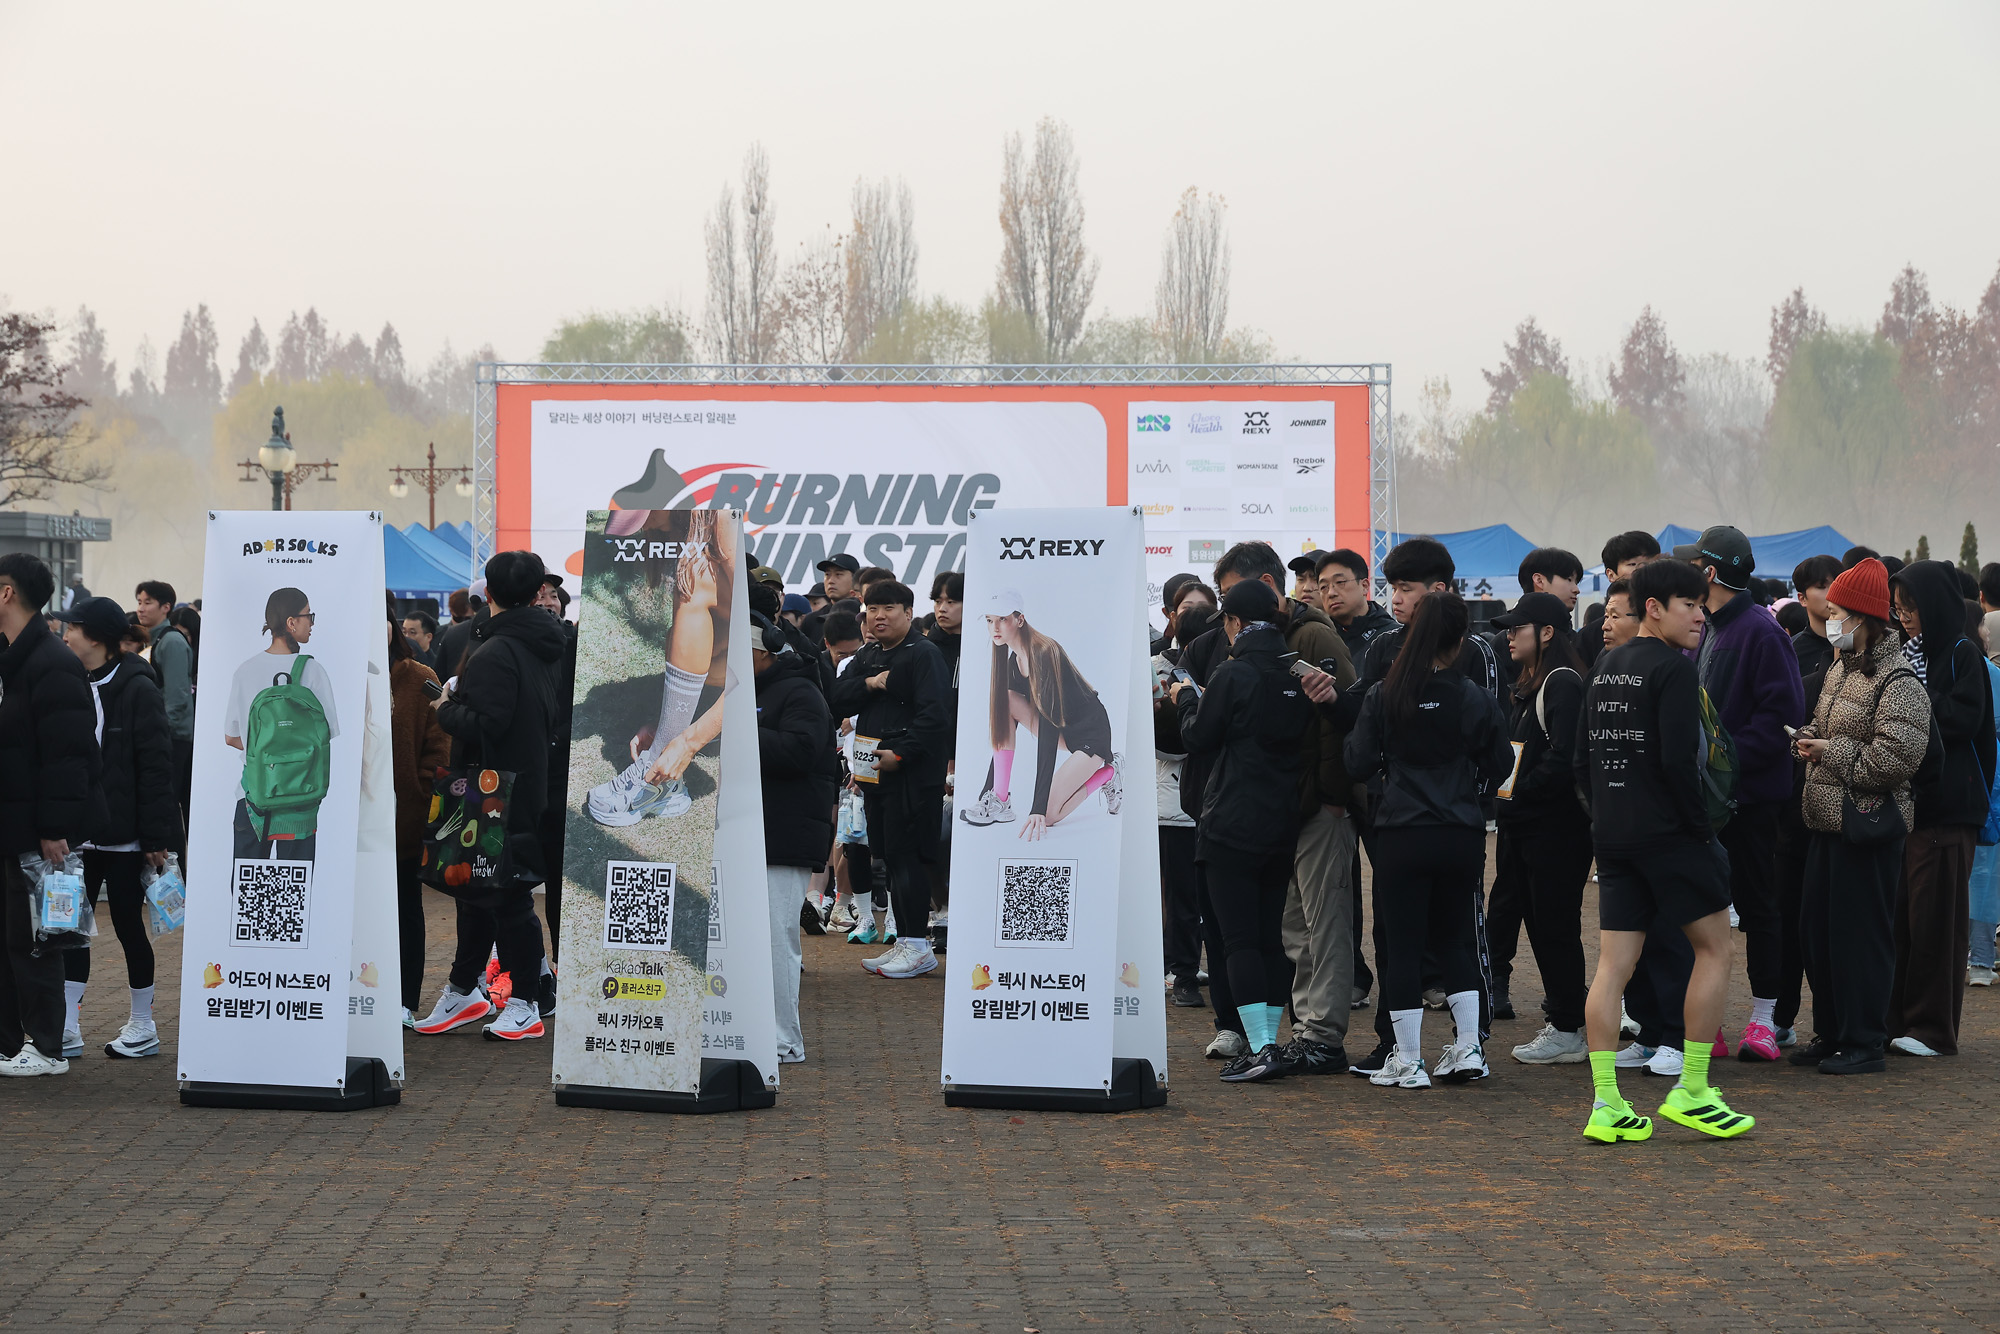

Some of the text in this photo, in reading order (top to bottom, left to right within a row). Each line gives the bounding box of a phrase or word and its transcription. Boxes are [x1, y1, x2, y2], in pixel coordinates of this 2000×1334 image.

[549, 412, 737, 425] 달리는 세상 이야기 버닝런스토리 일레븐
[1190, 412, 1221, 423] Choco
[1290, 419, 1327, 427] JOHNBER
[1188, 421, 1223, 434] Health
[1293, 457, 1326, 465] Reebok
[708, 473, 1001, 526] BURNING
[1241, 503, 1273, 514] SOLA
[648, 542, 707, 559] REXY
[1039, 540, 1105, 556] REXY
[745, 533, 852, 584] UN
[1592, 674, 1643, 687] RUNNING
[1597, 701, 1628, 712] WITH
[477, 854, 487, 866] I'm
[472, 863, 497, 878] fresh!
[606, 958, 664, 976] KakaoTalk
[228, 970, 331, 992] 어도어 N스토어
[998, 972, 1086, 992] 렉시 N스토어
[621, 982, 662, 996] 플러스친구
[207, 998, 324, 1021] 알림받기 이벤트
[972, 999, 1090, 1022] 알림받기 이벤트
[597, 1013, 664, 1032] 렉시 카카오톡
[584, 1036, 676, 1056] 플러스 친구 이벤트
